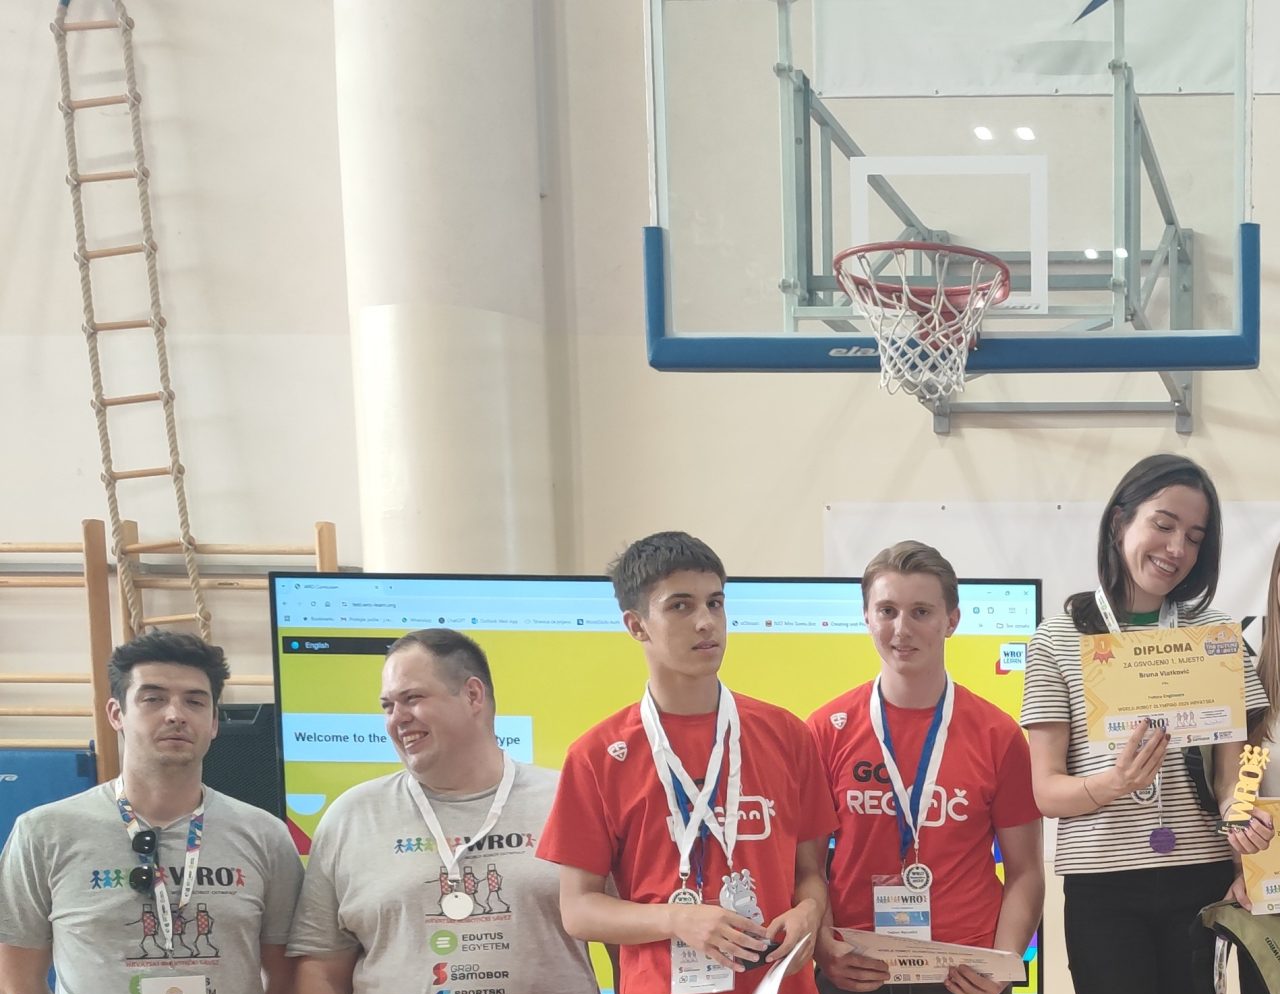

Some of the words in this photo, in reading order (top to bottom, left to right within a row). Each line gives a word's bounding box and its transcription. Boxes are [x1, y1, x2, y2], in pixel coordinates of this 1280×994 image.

[305, 641, 329, 651] English
[1133, 642, 1193, 656] DIPLOMA
[1123, 661, 1133, 669] ZA
[1134, 659, 1170, 668] OSVOJENO
[1178, 656, 1205, 665] MJESTO
[1138, 671, 1159, 679] Bruna
[294, 731, 350, 743] Welcome
[353, 733, 365, 743] to
[368, 733, 387, 743] the
[1227, 764, 1264, 822] WRO
[463, 832, 524, 852] WRO
[901, 895, 923, 904] WRO
[462, 932, 504, 942] EDUTUS
[461, 942, 510, 952] EGYETEM
[898, 958, 925, 967] WRO
